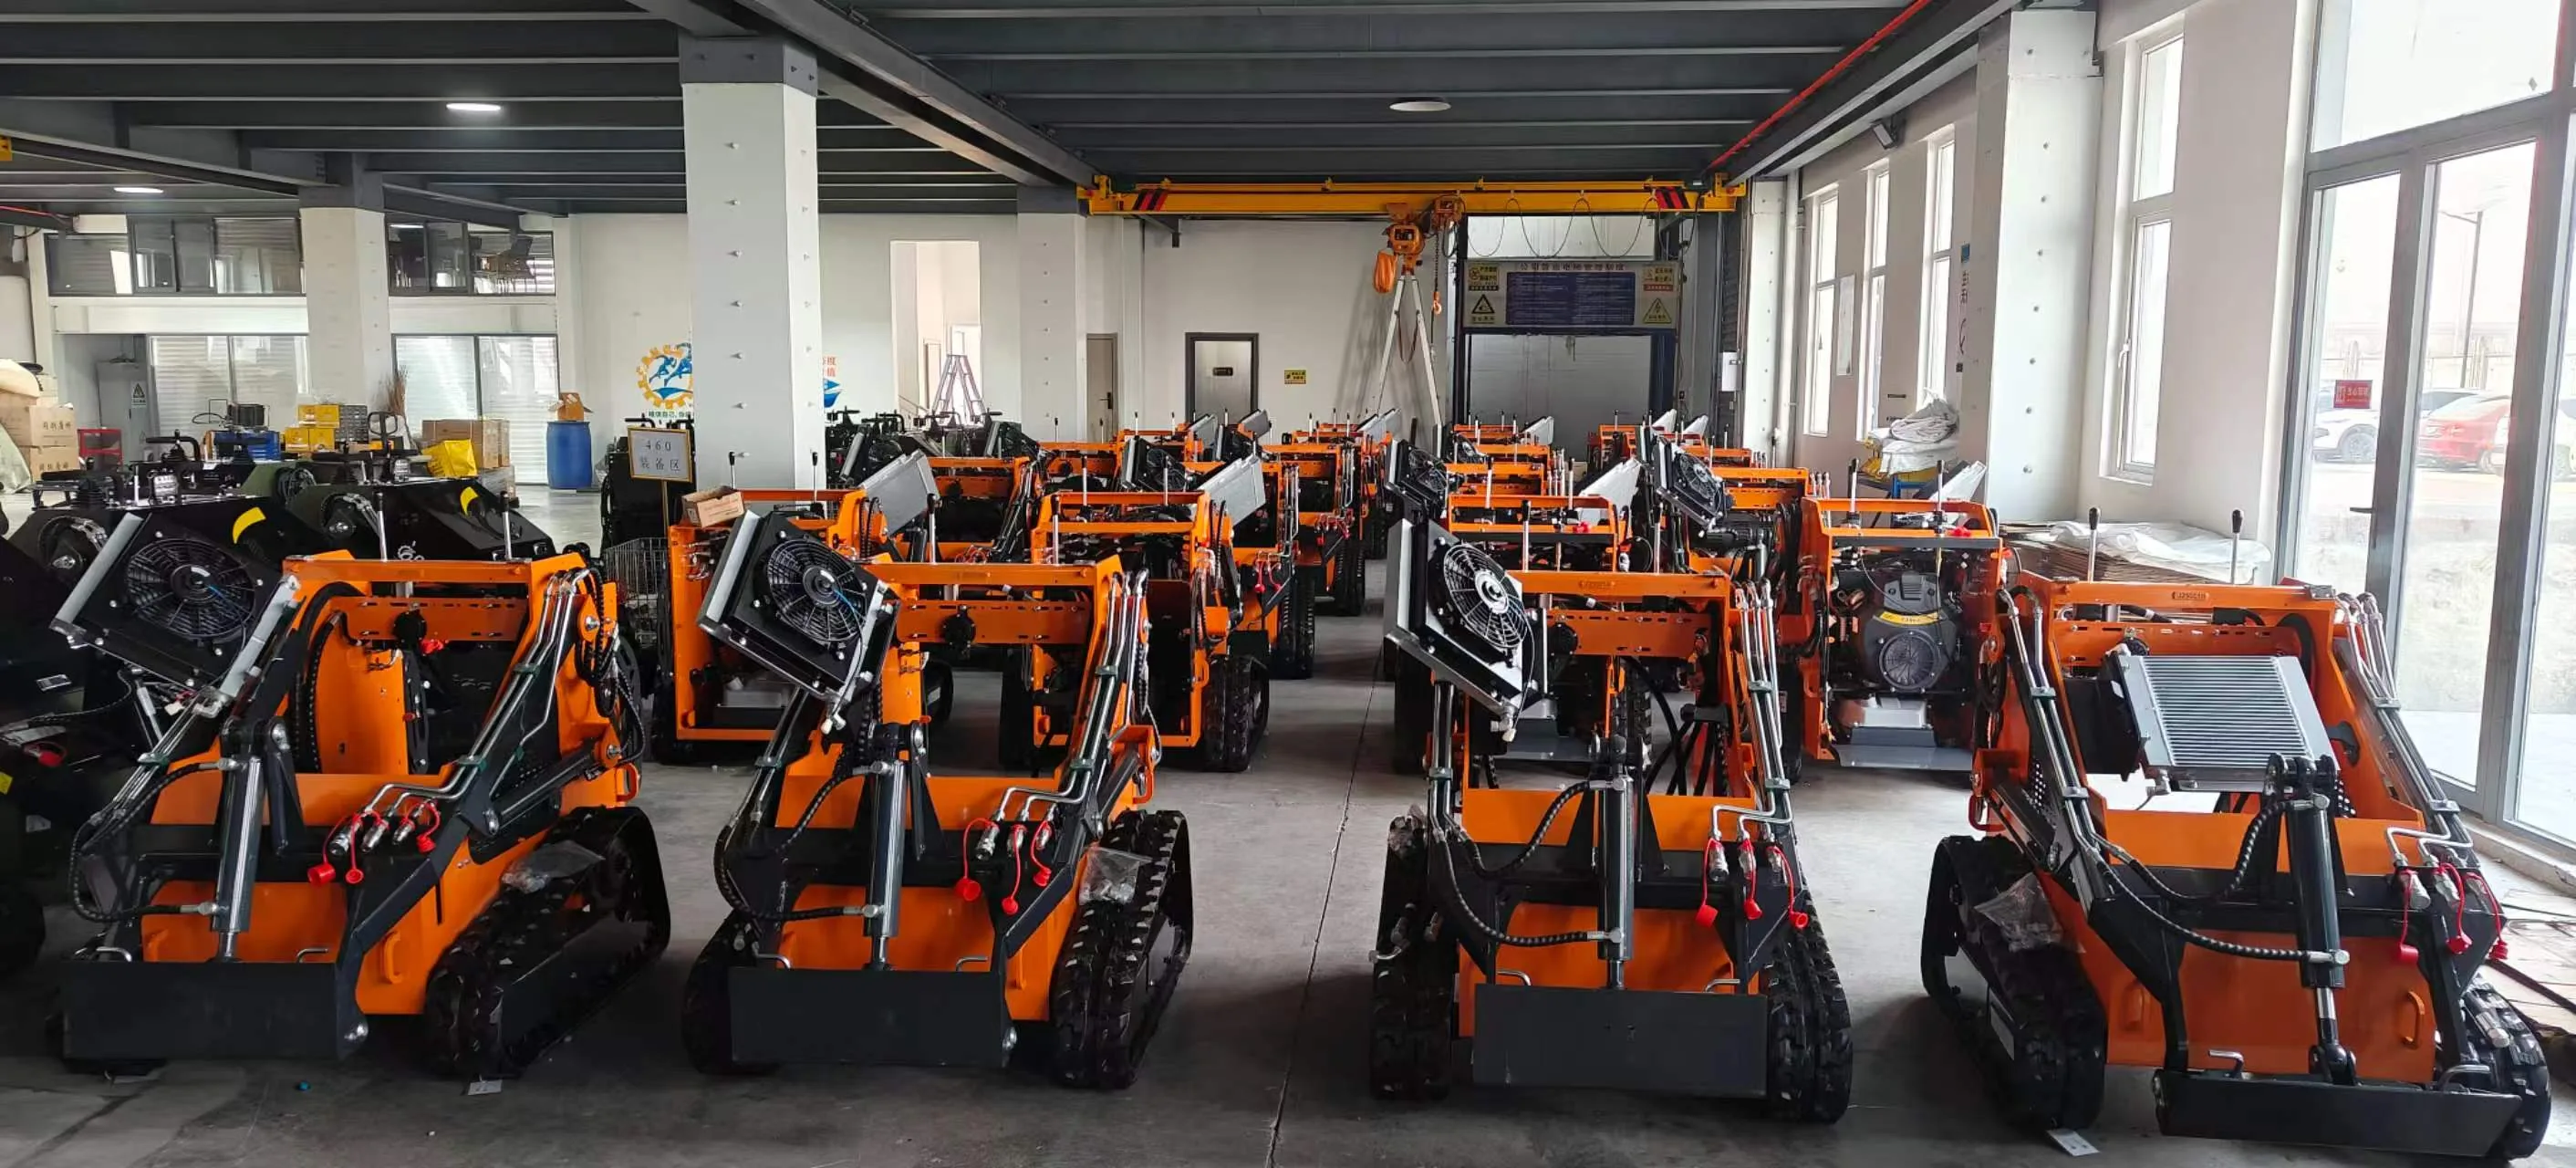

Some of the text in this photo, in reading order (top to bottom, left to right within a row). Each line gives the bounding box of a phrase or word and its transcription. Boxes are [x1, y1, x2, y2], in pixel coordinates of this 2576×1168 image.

[642, 440, 671, 452] 460
[640, 456, 680, 472] 装备区
